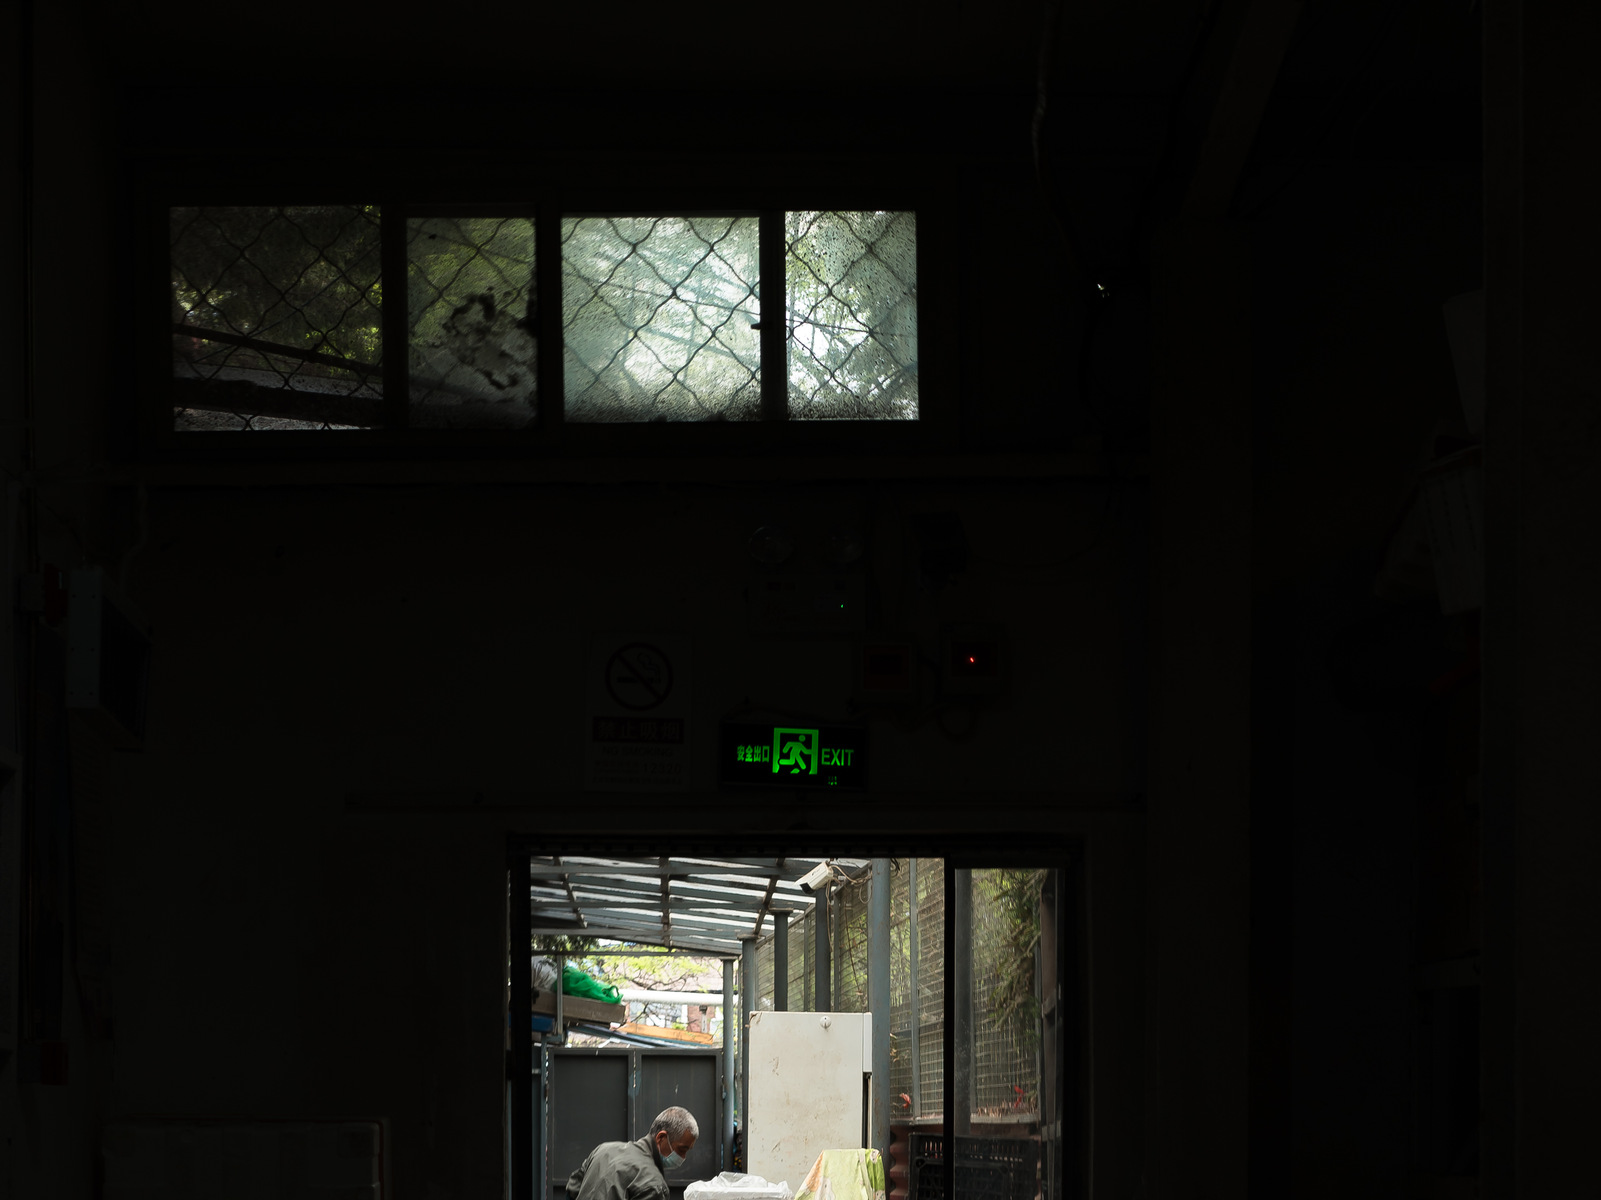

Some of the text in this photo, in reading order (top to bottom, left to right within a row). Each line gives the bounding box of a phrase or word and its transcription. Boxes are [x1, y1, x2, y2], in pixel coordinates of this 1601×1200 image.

[736, 744, 770, 763] 安全出口
[821, 748, 855, 767] EXIT
